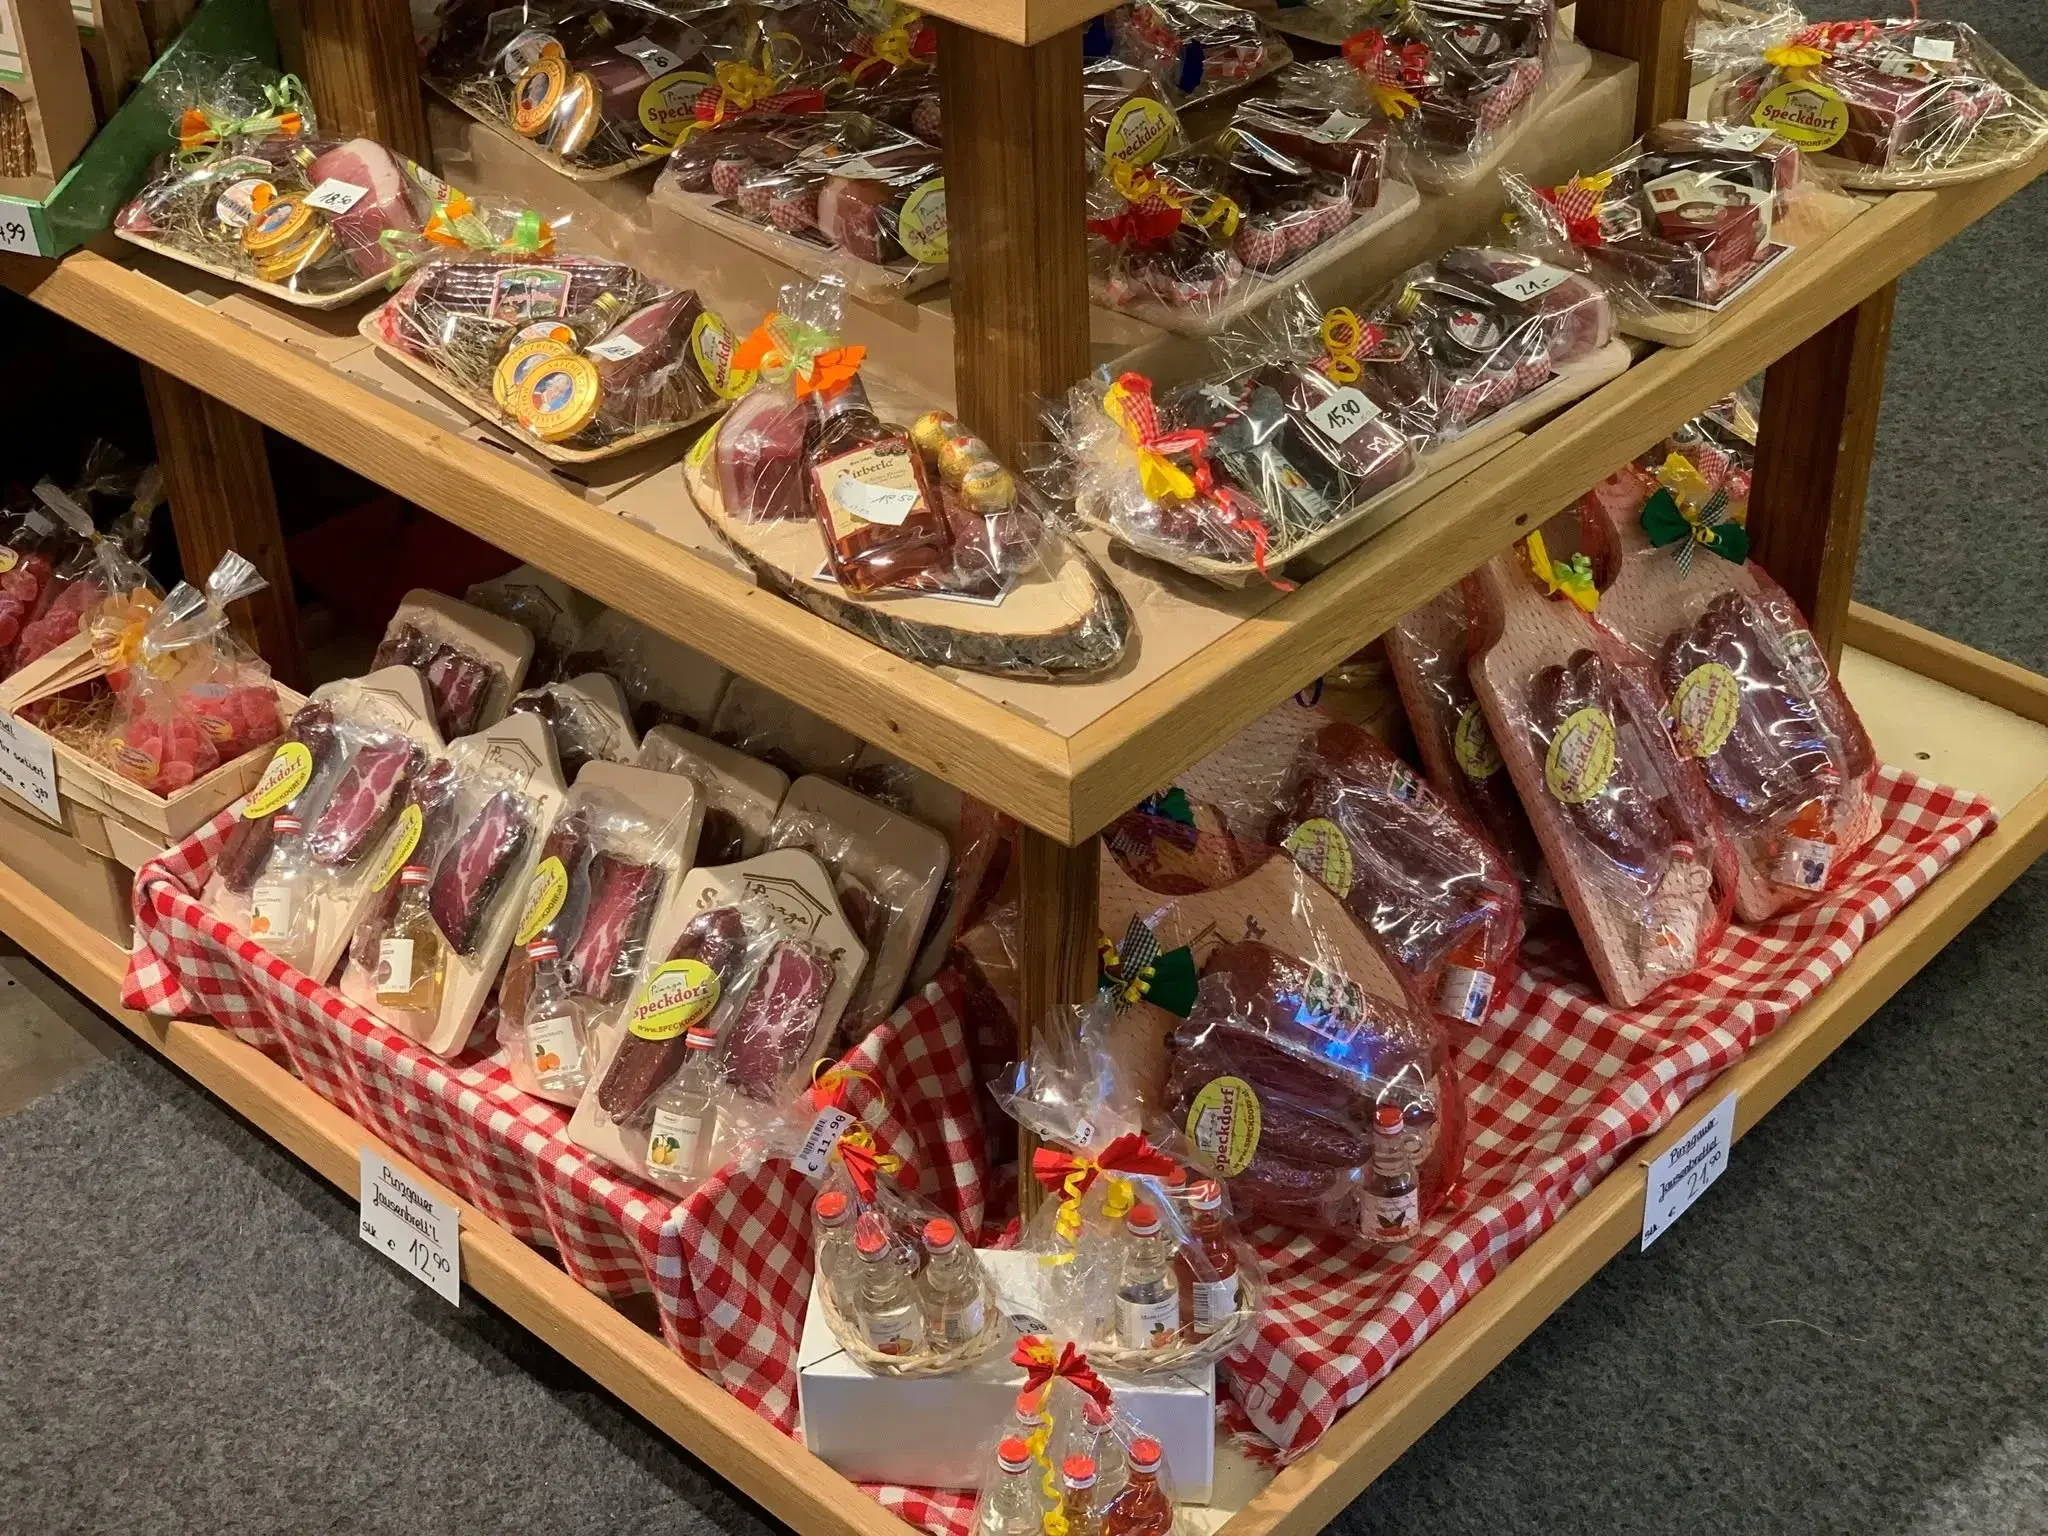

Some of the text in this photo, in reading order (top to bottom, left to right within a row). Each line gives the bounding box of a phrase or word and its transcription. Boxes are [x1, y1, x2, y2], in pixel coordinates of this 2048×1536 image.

[647, 103, 696, 124] Speck
[1761, 104, 1839, 130] Speckdorf
[907, 214, 948, 246] Speck
[1327, 399, 1361, 430] 15,90
[807, 1114, 847, 1172] € 11,90
[383, 1165, 433, 1214] Pinzgauer
[386, 1239, 397, 1251] €
[408, 1238, 451, 1283] 12,90
